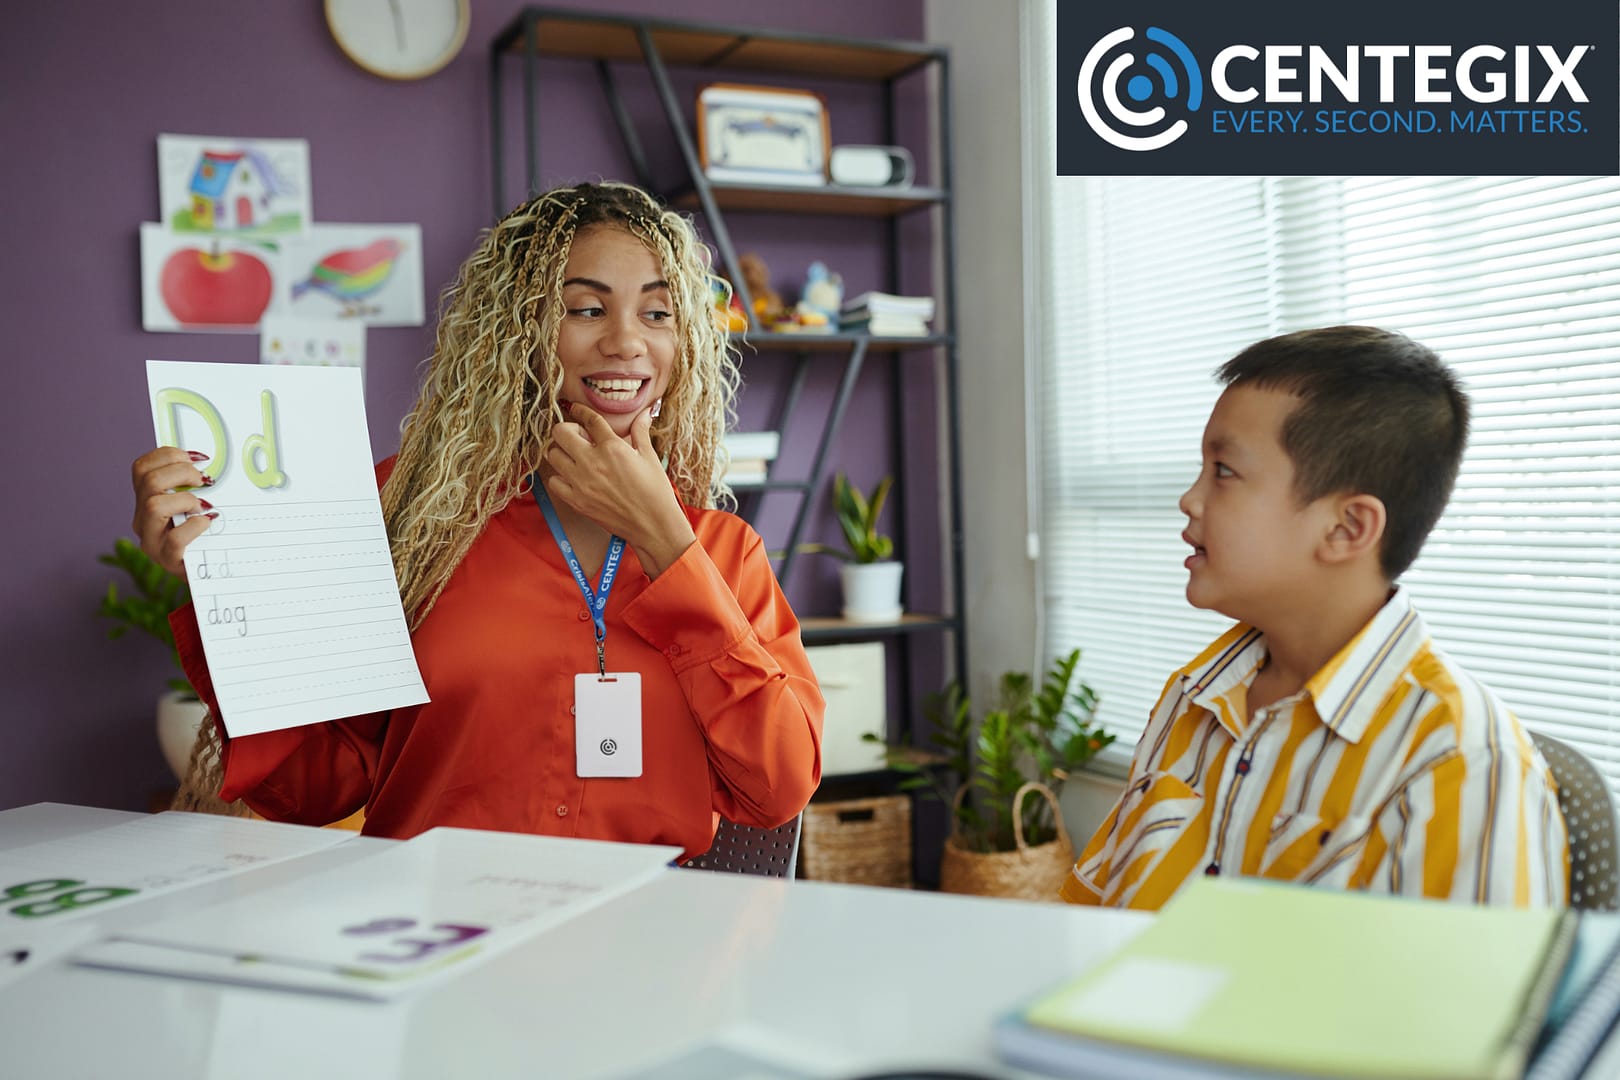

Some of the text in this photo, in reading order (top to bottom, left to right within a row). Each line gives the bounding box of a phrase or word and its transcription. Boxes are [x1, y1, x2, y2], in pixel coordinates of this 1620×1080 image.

[569, 558, 595, 608] CrisisAler
[600, 536, 624, 592] CENTEGI
[207, 594, 248, 637] dog
